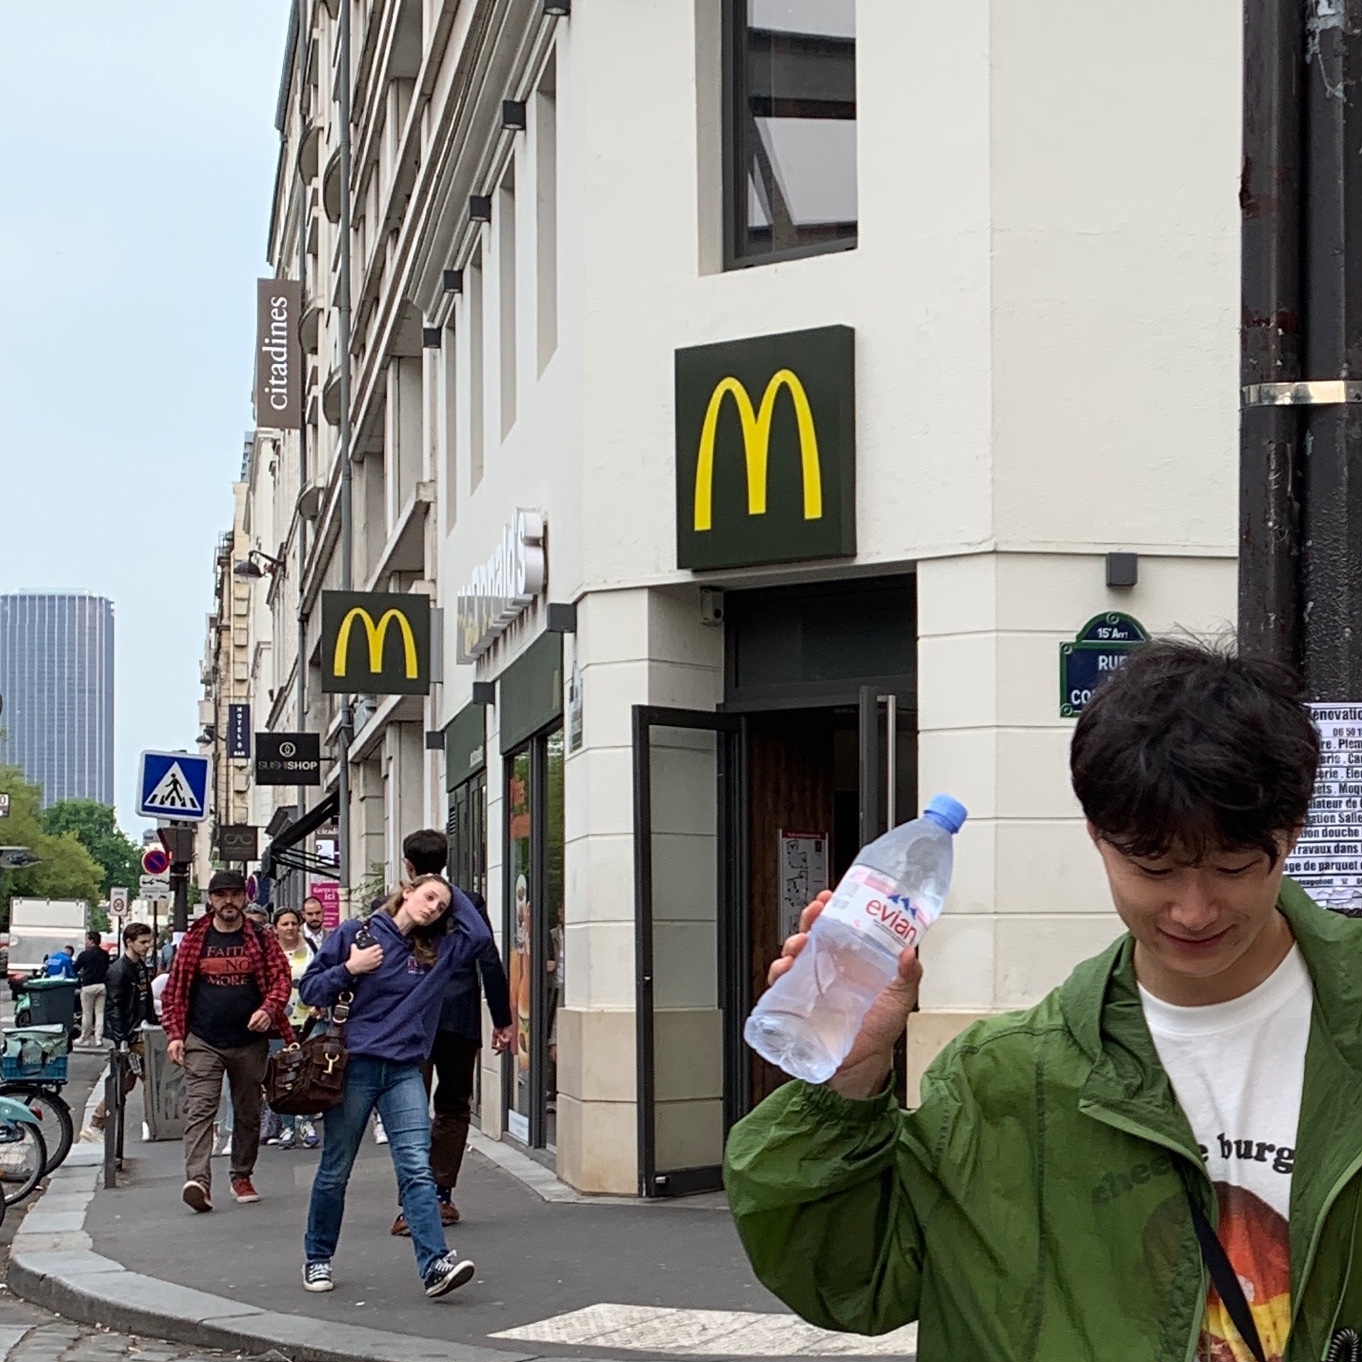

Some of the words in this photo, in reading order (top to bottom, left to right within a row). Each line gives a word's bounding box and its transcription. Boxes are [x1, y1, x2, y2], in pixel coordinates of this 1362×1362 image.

[262, 296, 288, 410] citadines
[1319, 753, 1341, 765] erie
[1321, 826, 1359, 838] douche
[1333, 842, 1358, 854] dans
[1303, 860, 1316, 871] de
[1319, 860, 1358, 873] parquet
[865, 900, 917, 945] evian
[226, 960, 250, 971] NO
[1217, 1133, 1295, 1174] burg
